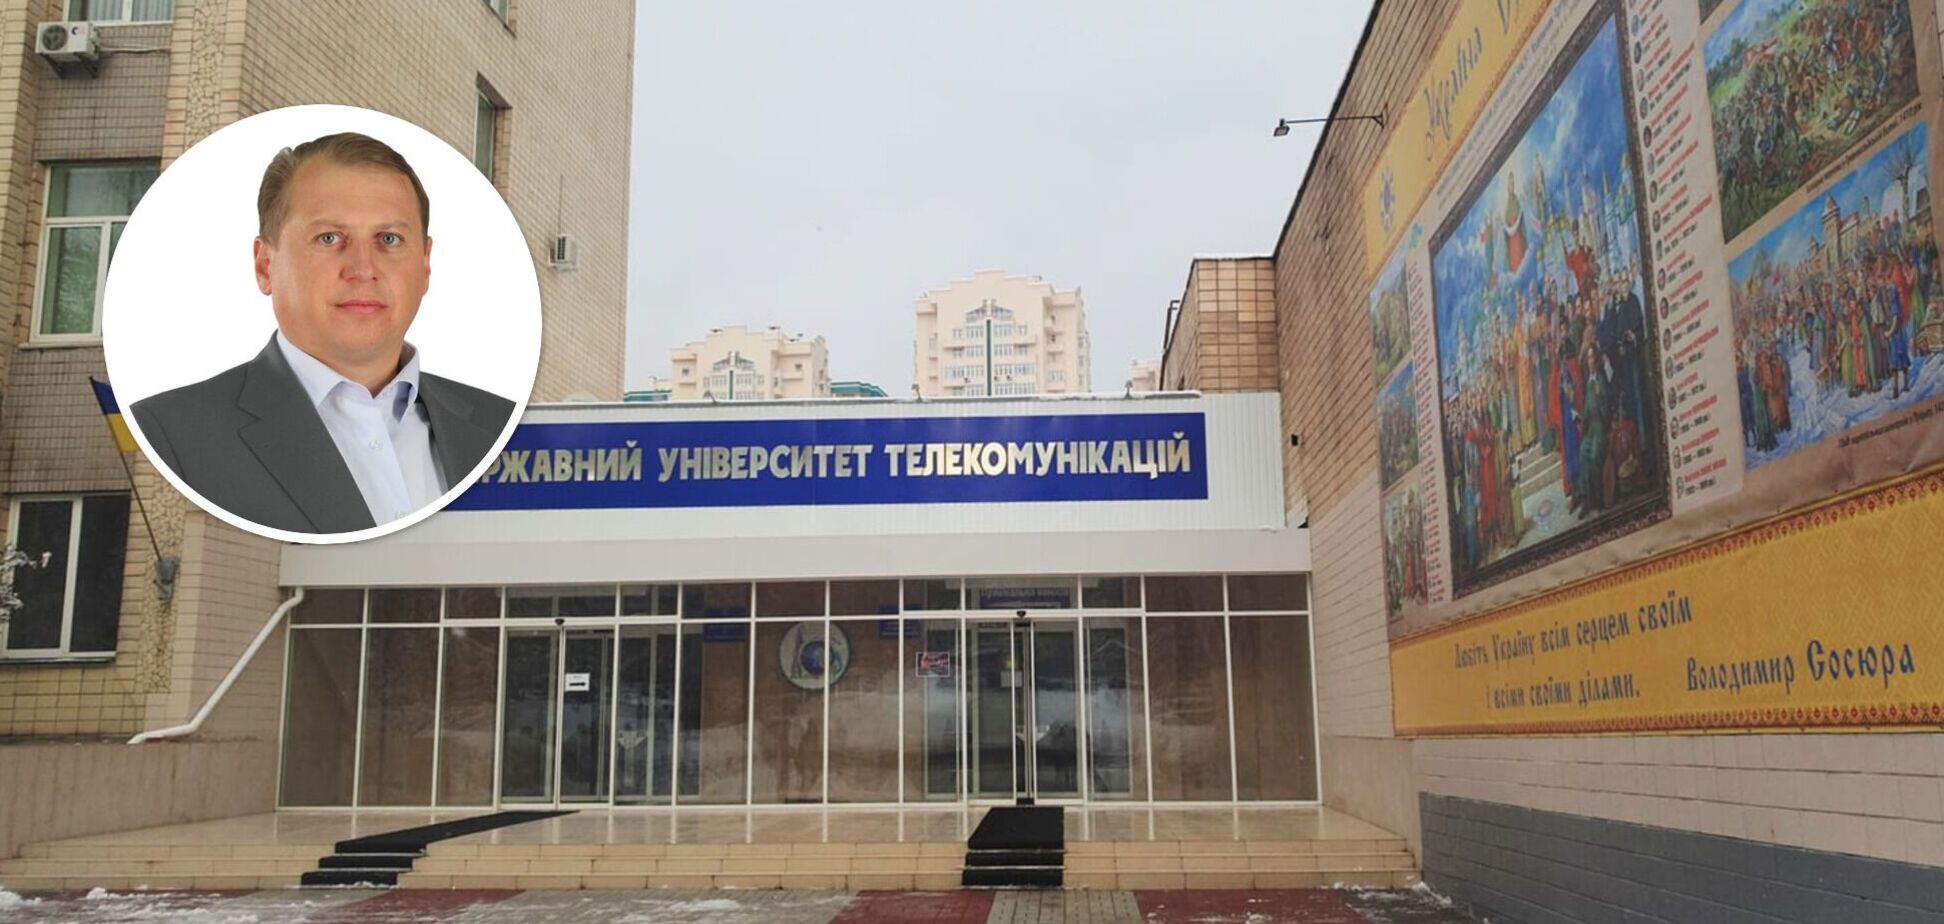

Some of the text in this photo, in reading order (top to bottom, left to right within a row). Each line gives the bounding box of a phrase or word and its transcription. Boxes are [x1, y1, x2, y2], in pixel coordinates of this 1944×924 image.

[479, 431, 1191, 483] РЖАВНИЙ УНІВЕРСИТЕТ ТЕЛЕКОМУНІКАЦІЙ
[1541, 621, 1571, 652] всім
[1576, 611, 1629, 653] серцем
[1638, 590, 1693, 633] своїм
[1494, 683, 1525, 708] всіми
[1530, 676, 1572, 707] своїми
[1578, 671, 1640, 709] ділами.
[1686, 640, 1915, 694] Володимир Сосюра
